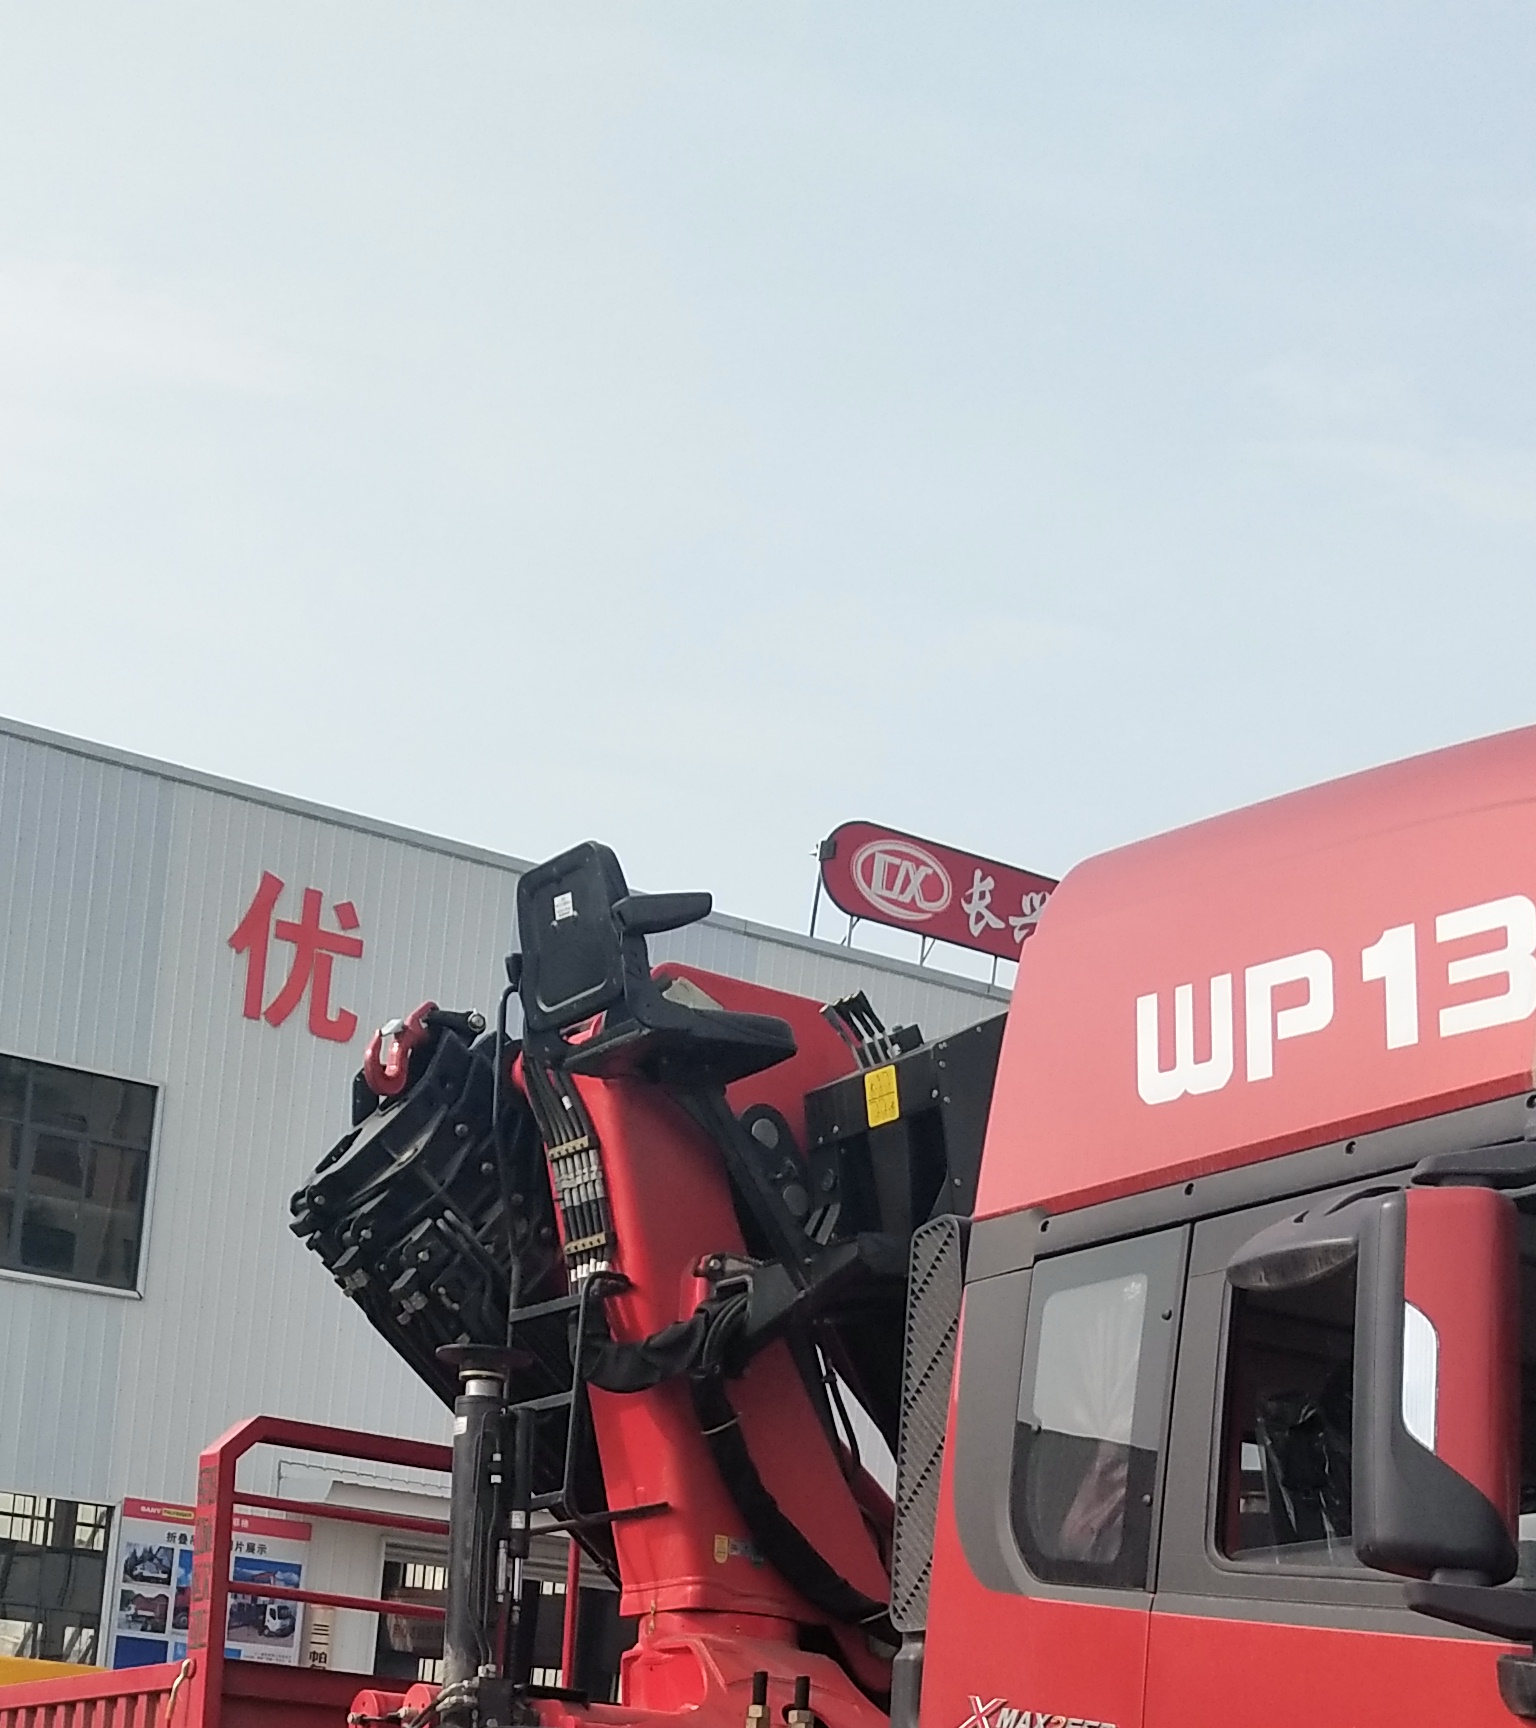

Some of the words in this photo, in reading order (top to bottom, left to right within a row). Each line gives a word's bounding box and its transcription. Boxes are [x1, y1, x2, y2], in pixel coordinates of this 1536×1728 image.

[227, 870, 364, 1043] 优
[230, 1540, 267, 1555] 片展示
